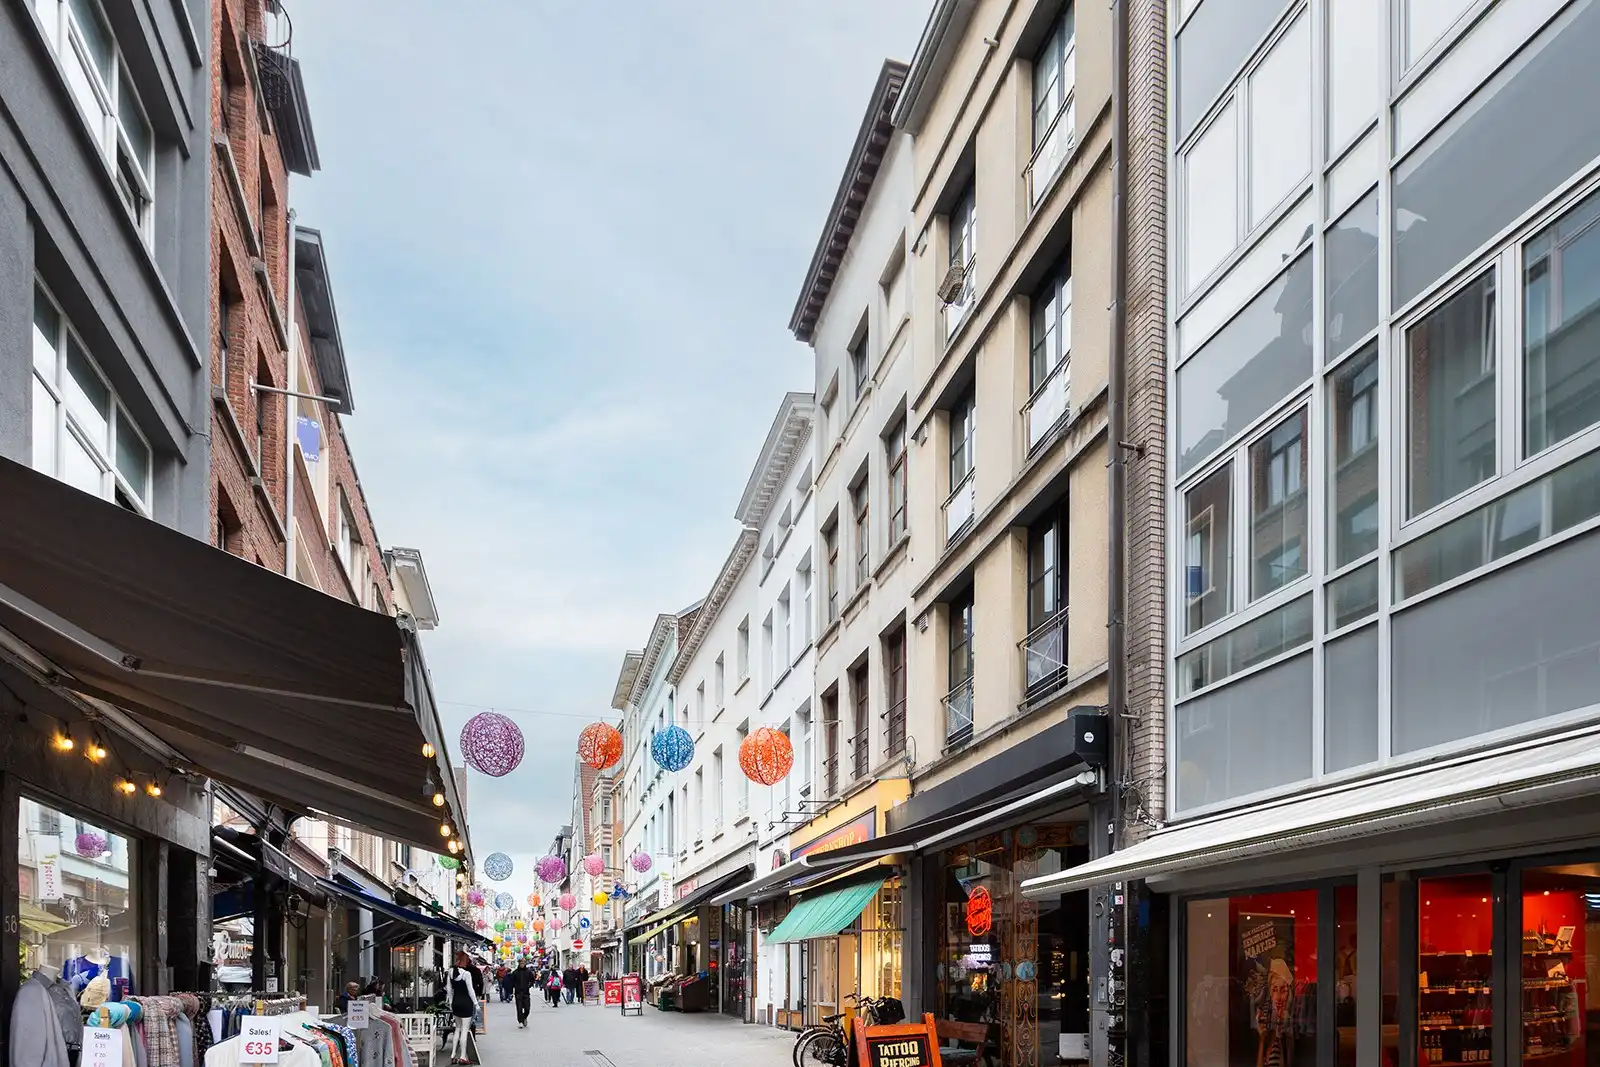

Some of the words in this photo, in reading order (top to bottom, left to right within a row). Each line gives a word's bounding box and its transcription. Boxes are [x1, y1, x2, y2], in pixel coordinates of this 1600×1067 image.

[4, 915, 18, 933] 58
[249, 1027, 272, 1036] Sales!
[245, 1041, 272, 1055] €35
[878, 1041, 919, 1056] TATTOO
[880, 1057, 920, 1067] PIERCING
